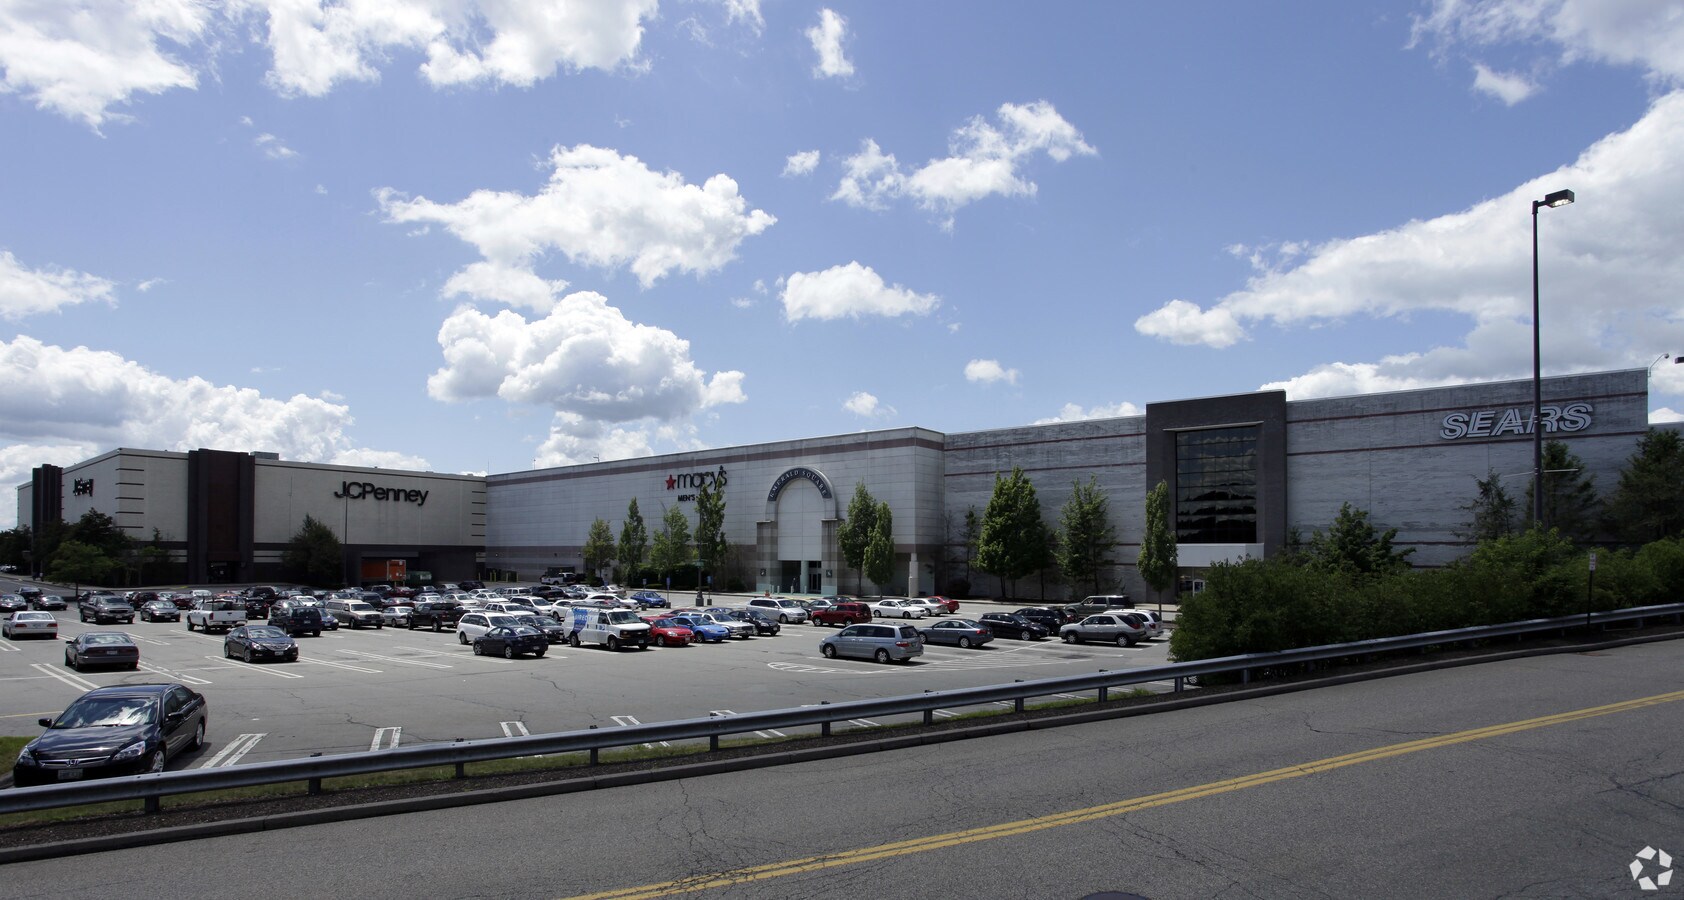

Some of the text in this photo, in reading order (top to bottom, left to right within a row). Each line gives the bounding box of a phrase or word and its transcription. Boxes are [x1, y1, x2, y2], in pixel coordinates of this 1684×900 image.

[1440, 403, 1593, 440] SEARS
[334, 480, 430, 506] JCPenney
[769, 470, 827, 498] EMERALD SQUARE
